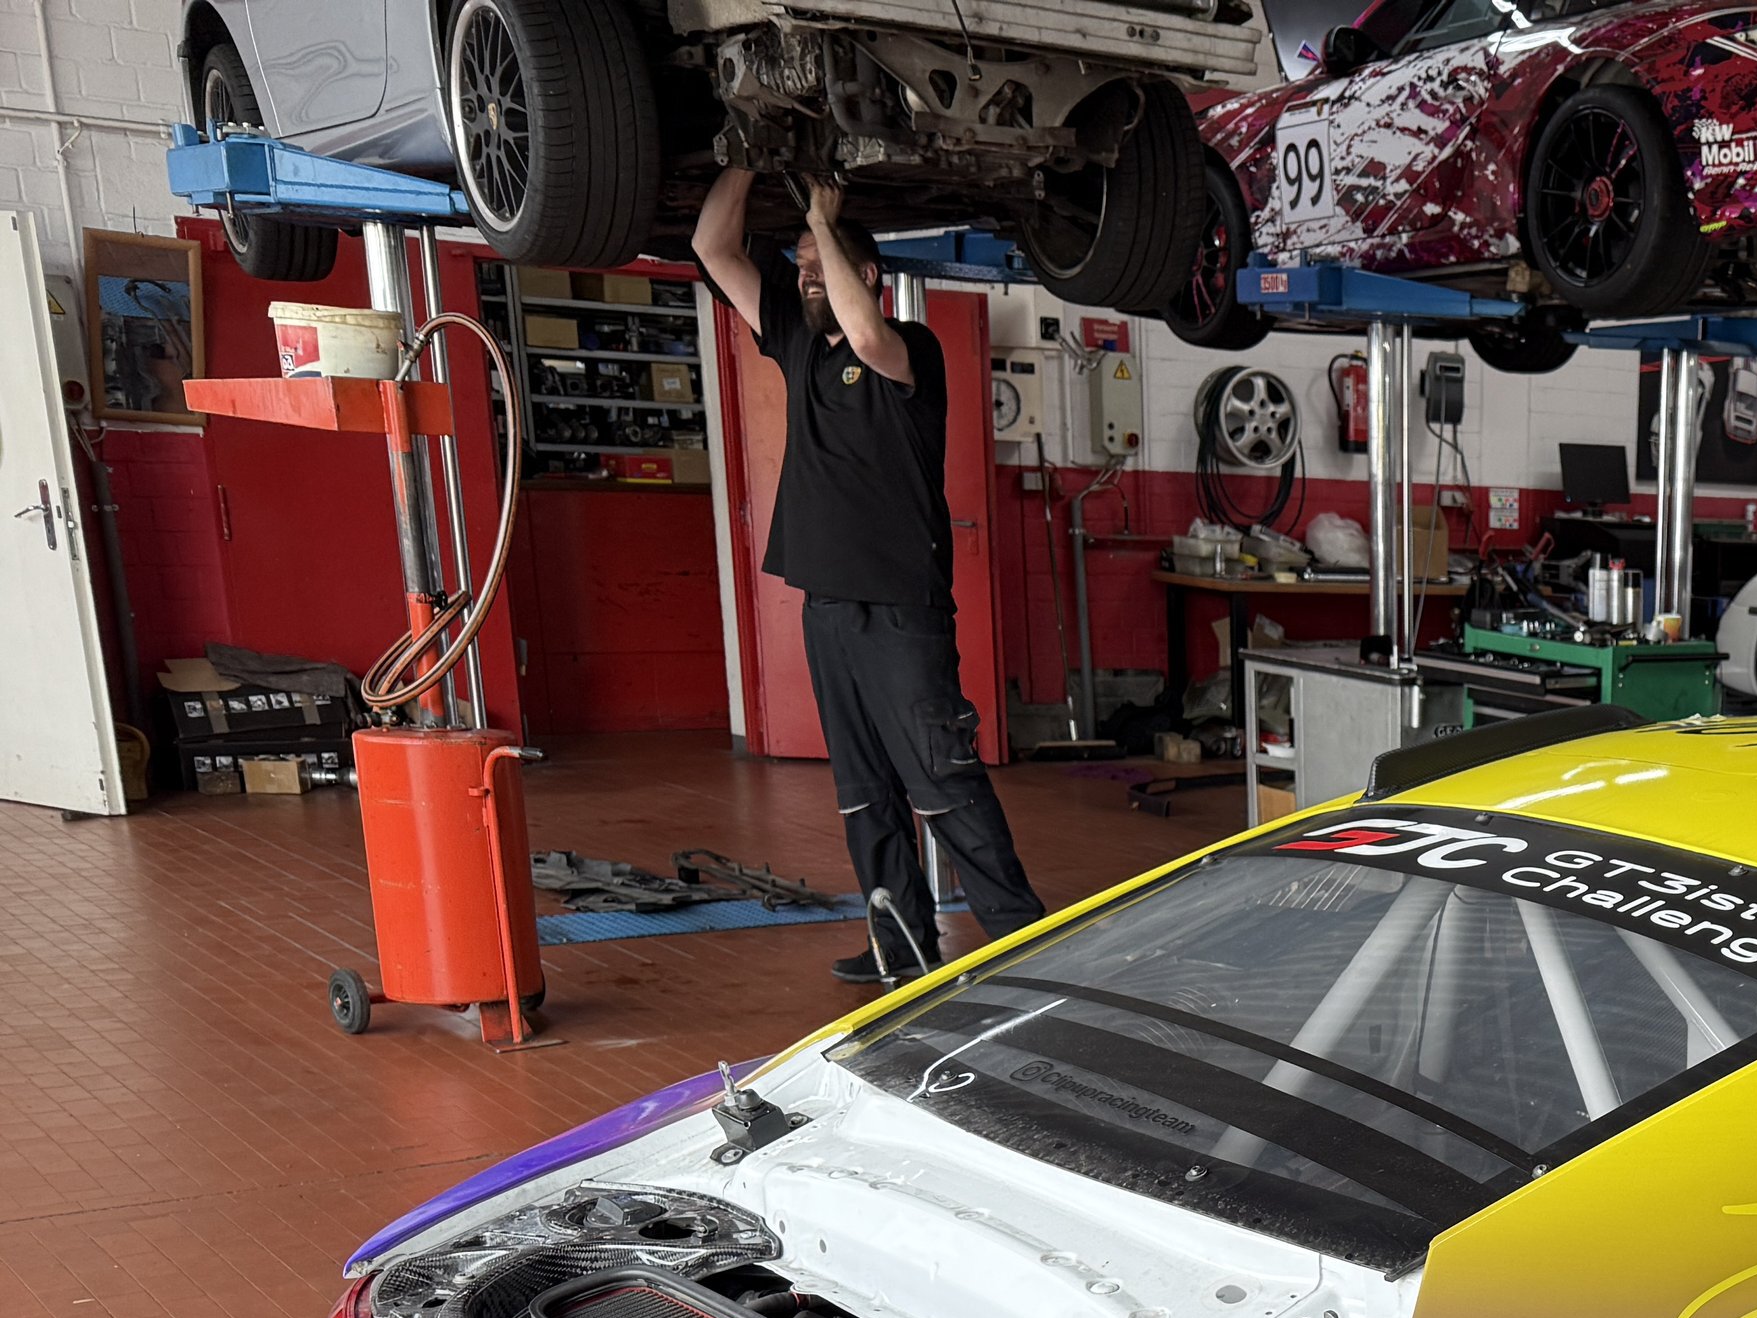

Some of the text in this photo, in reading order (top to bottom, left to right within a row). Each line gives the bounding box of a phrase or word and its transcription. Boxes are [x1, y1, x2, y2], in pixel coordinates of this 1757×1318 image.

[1699, 123, 1734, 143] KW
[1701, 140, 1755, 166] Mobil
[1282, 138, 1325, 211] 99
